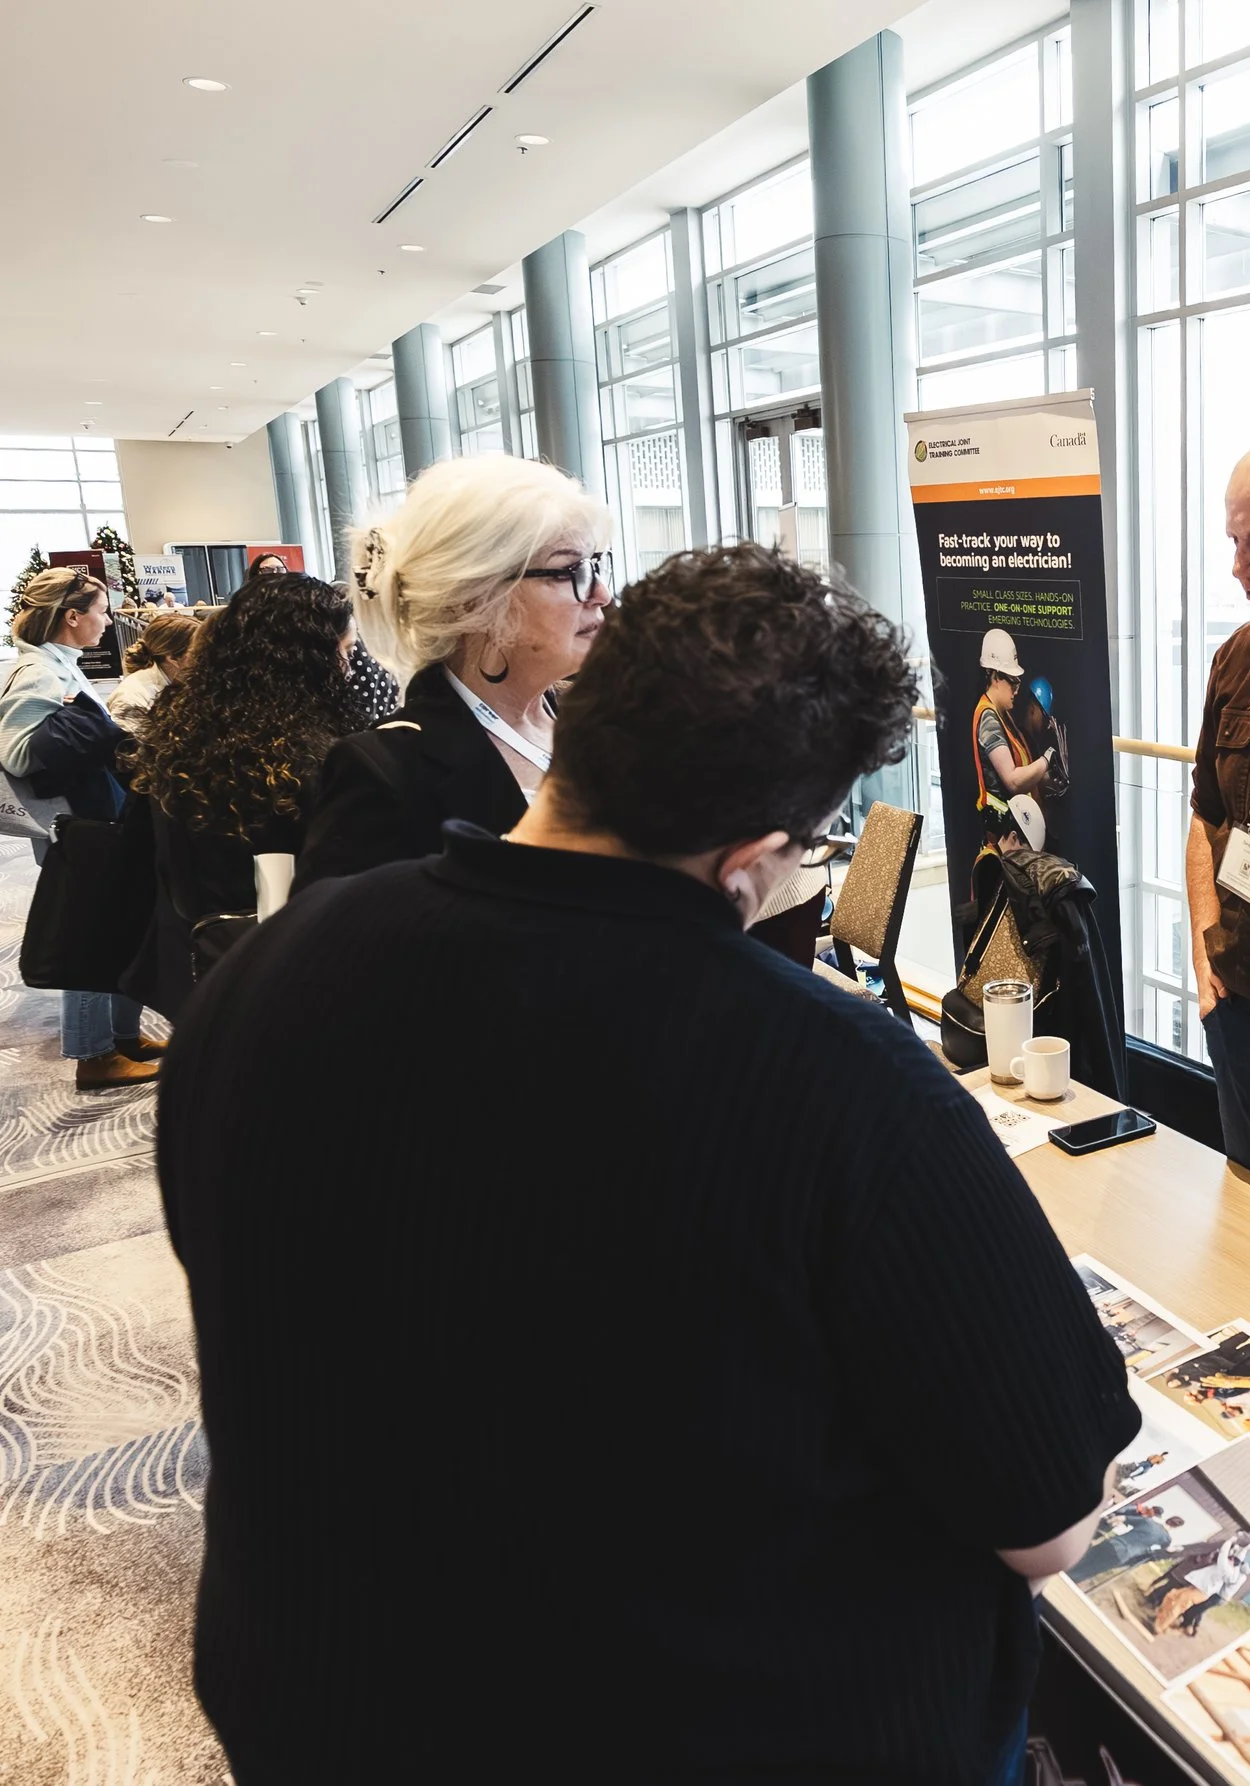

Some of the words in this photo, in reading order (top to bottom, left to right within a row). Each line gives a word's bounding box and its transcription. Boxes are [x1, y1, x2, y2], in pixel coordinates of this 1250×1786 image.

[928, 439, 956, 449] ELECTRICAL
[957, 437, 971, 447] JOINT
[1049, 432, 1087, 448] Canada
[929, 450, 953, 459] TRAINING
[953, 447, 980, 457] COMMITTEE
[938, 532, 991, 549] Fast-track
[994, 535, 1017, 551] your
[1019, 535, 1044, 551] way
[1047, 533, 1061, 548] to
[939, 552, 989, 571] becoming
[992, 555, 1006, 568] an
[1008, 552, 1072, 569] electrician!
[972, 589, 994, 599] SMALL
[995, 590, 1015, 600] CLASS
[1015, 591, 1034, 601] SIZES.
[1035, 592, 1074, 603] HANDS-ON
[960, 601, 992, 611] PRACTICE.
[993, 602, 1037, 613] ONE-ON-ONE
[1037, 605, 1075, 616] SUPPORT.
[988, 614, 1021, 626] EMERGING
[1022, 616, 1076, 629] TECHNOLOGIES.
